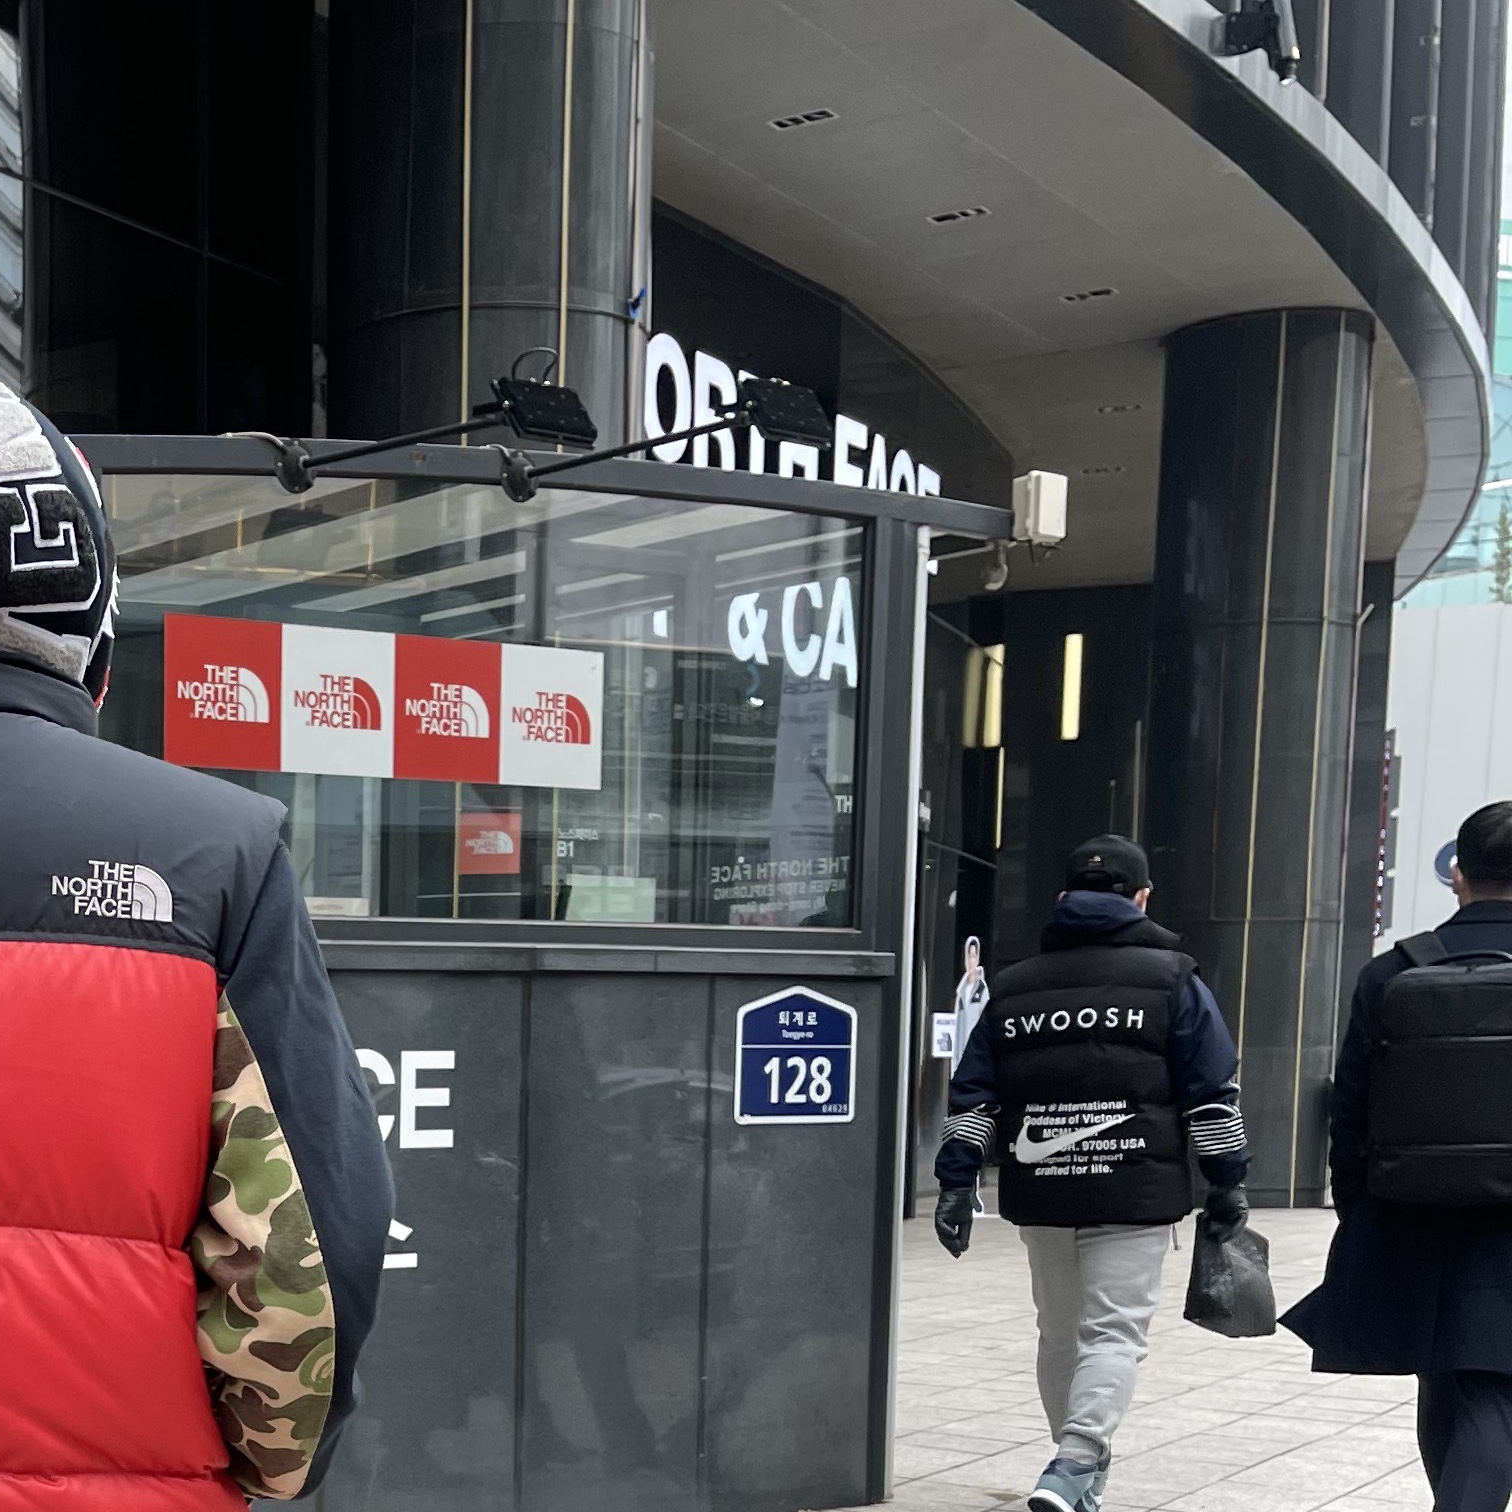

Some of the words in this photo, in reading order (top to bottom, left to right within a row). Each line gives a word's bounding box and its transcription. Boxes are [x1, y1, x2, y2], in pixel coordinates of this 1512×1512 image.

[203, 664, 238, 684] THE
[319, 674, 352, 693] THE
[177, 680, 238, 702] NORTH
[294, 690, 352, 711] NORTH
[430, 682, 460, 701] THE
[535, 691, 565, 709] THE
[194, 701, 238, 721] FACE
[405, 698, 460, 719] NORTH
[511, 707, 564, 726] NORTH
[310, 710, 352, 729] FACE
[420, 717, 460, 736] FACE
[526, 725, 564, 743] FACE
[557, 841, 575, 858] B1
[88, 860, 135, 881] THE
[51, 875, 133, 900] NORTH
[74, 896, 132, 918] FACE
[778, 1011, 819, 1026] 퇴계로
[1004, 1007, 1144, 1038] SWOOSH
[763, 1056, 832, 1104] 128
[1058, 1099, 1127, 1112] International
[1023, 1115, 1067, 1126] Goddess
[1068, 1114, 1080, 1125] of
[1082, 1139, 1118, 1151] 97005
[1120, 1138, 1146, 1149] USA
[1035, 1165, 1070, 1176] crafted
[1072, 1165, 1088, 1175] for
